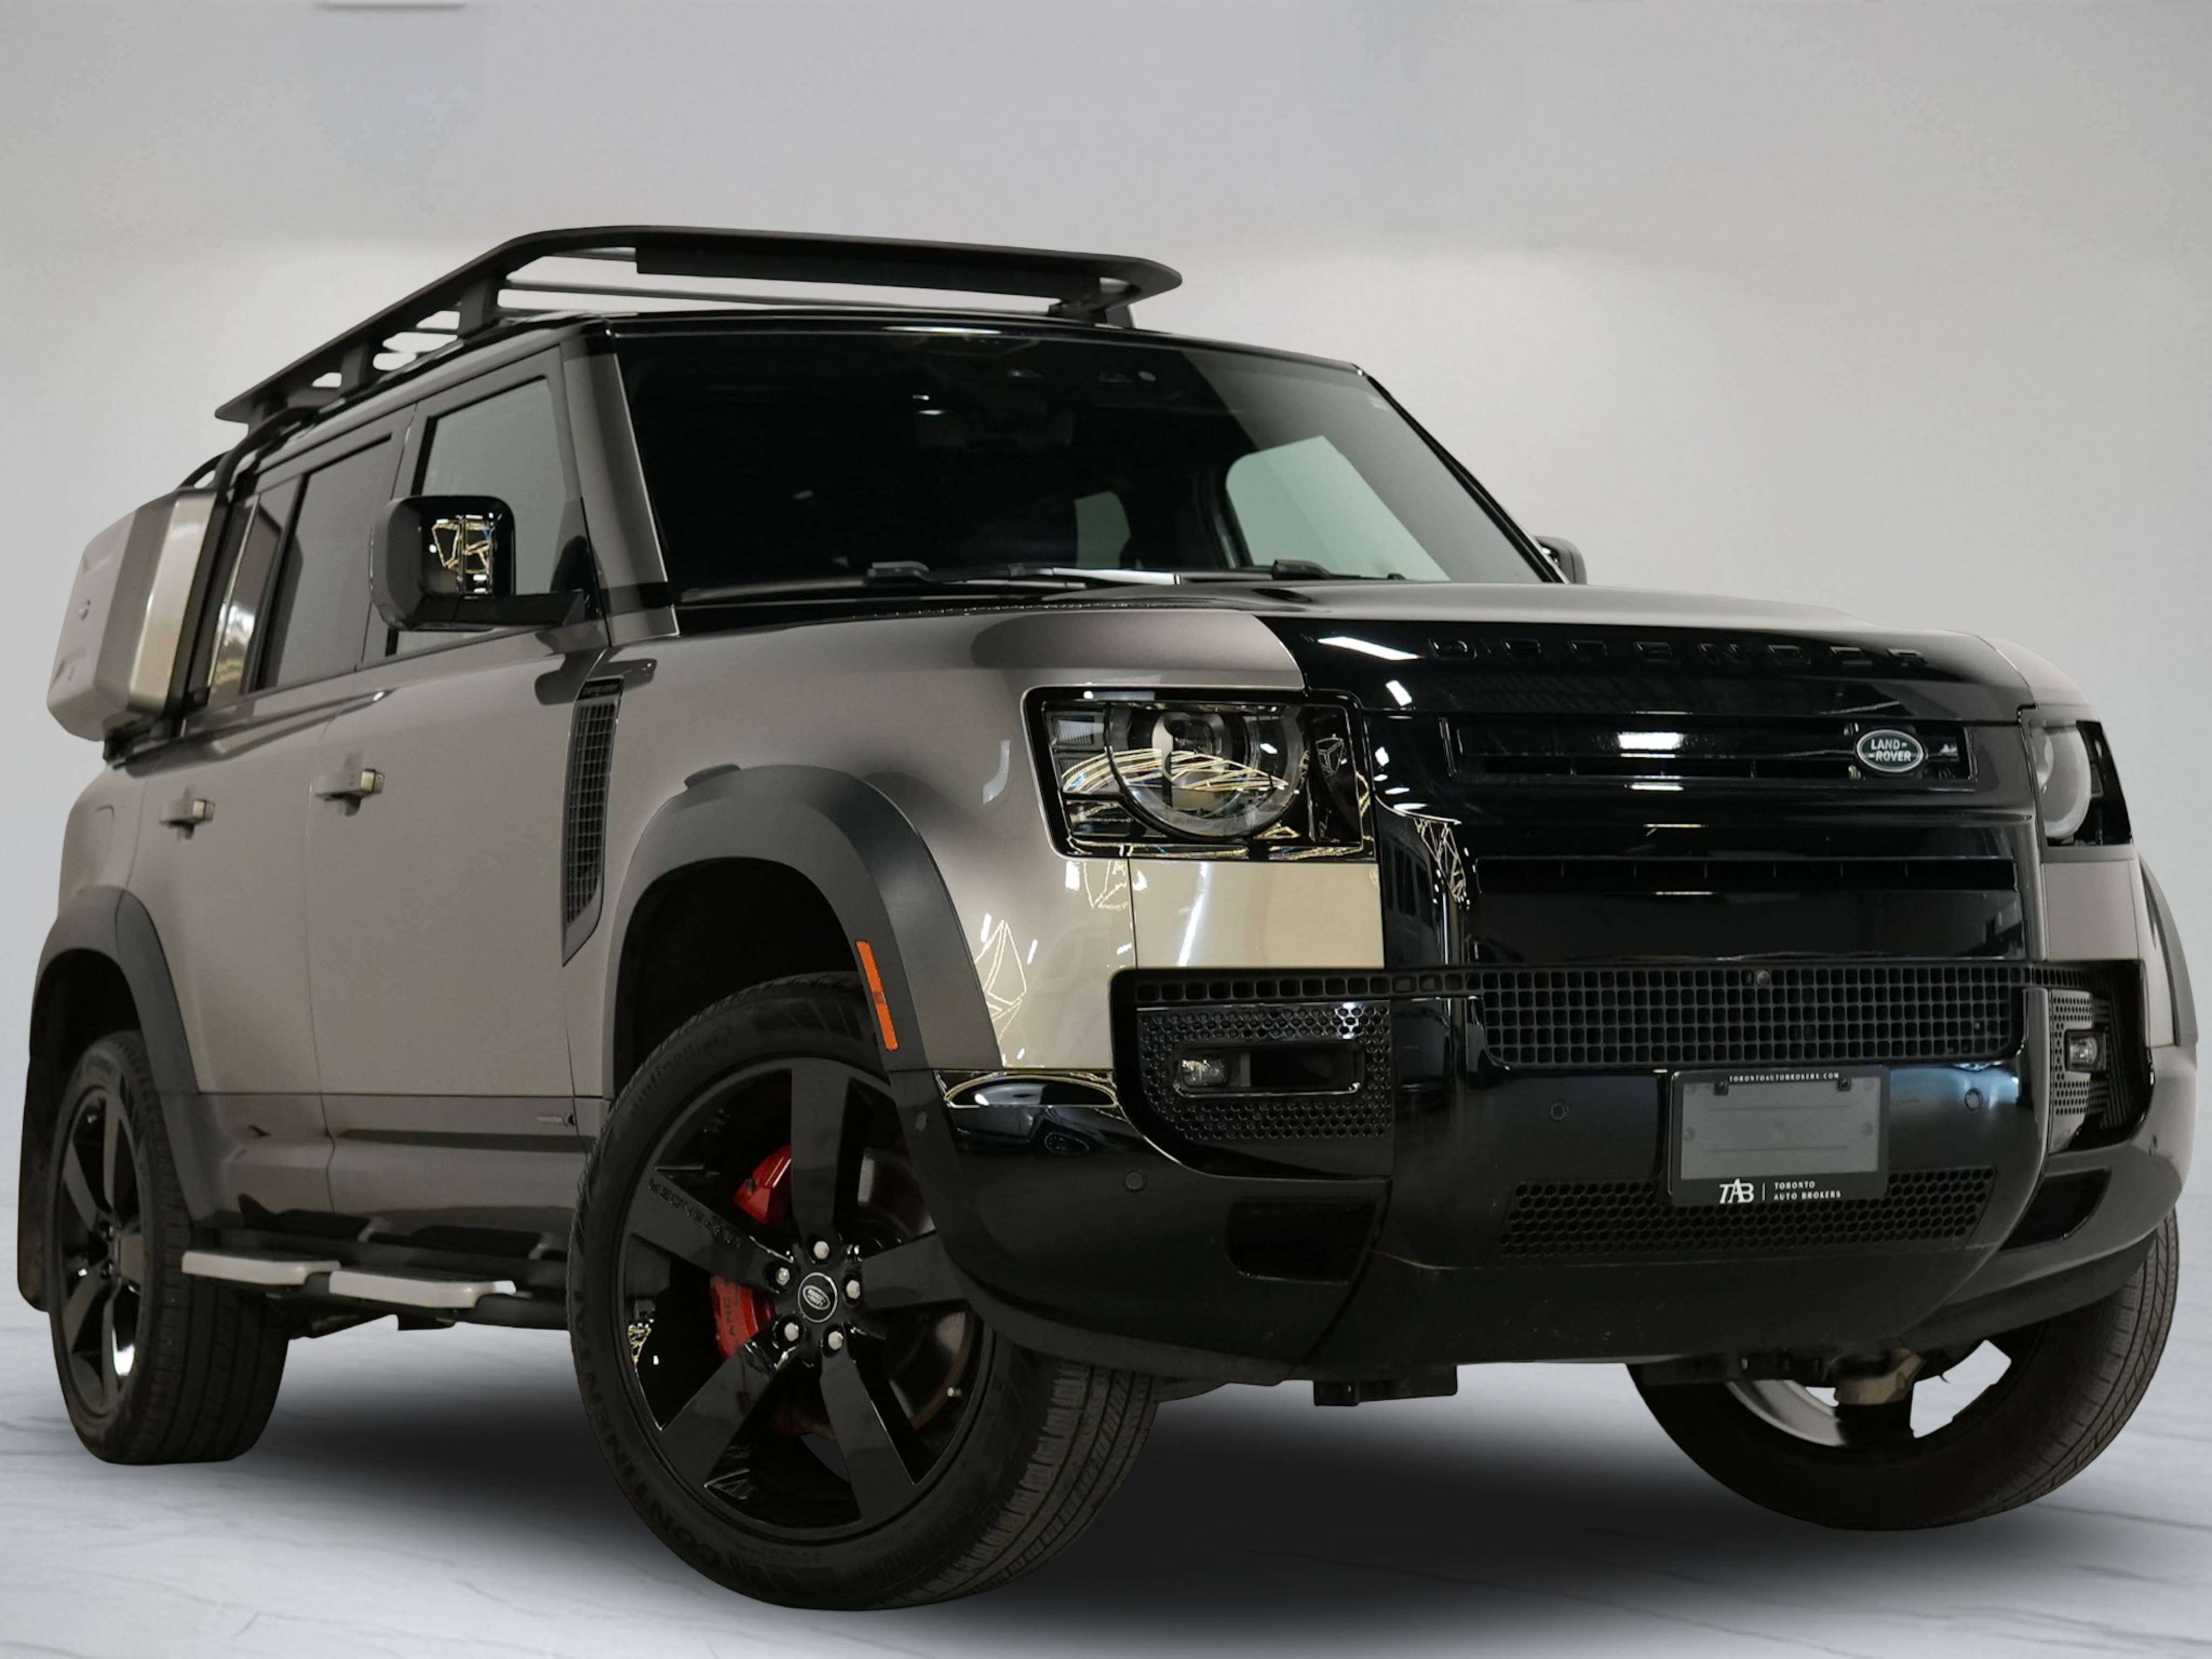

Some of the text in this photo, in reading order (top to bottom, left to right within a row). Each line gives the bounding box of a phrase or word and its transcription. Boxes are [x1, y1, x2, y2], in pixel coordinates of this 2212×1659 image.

[1871, 738, 1900, 750] LAND
[1874, 750, 1912, 762] ROVER
[1719, 1178, 1755, 1204] TAB
[1774, 1181, 1815, 1190] TORONTO
[1773, 1190, 1842, 1201] AUTO BROKERS
